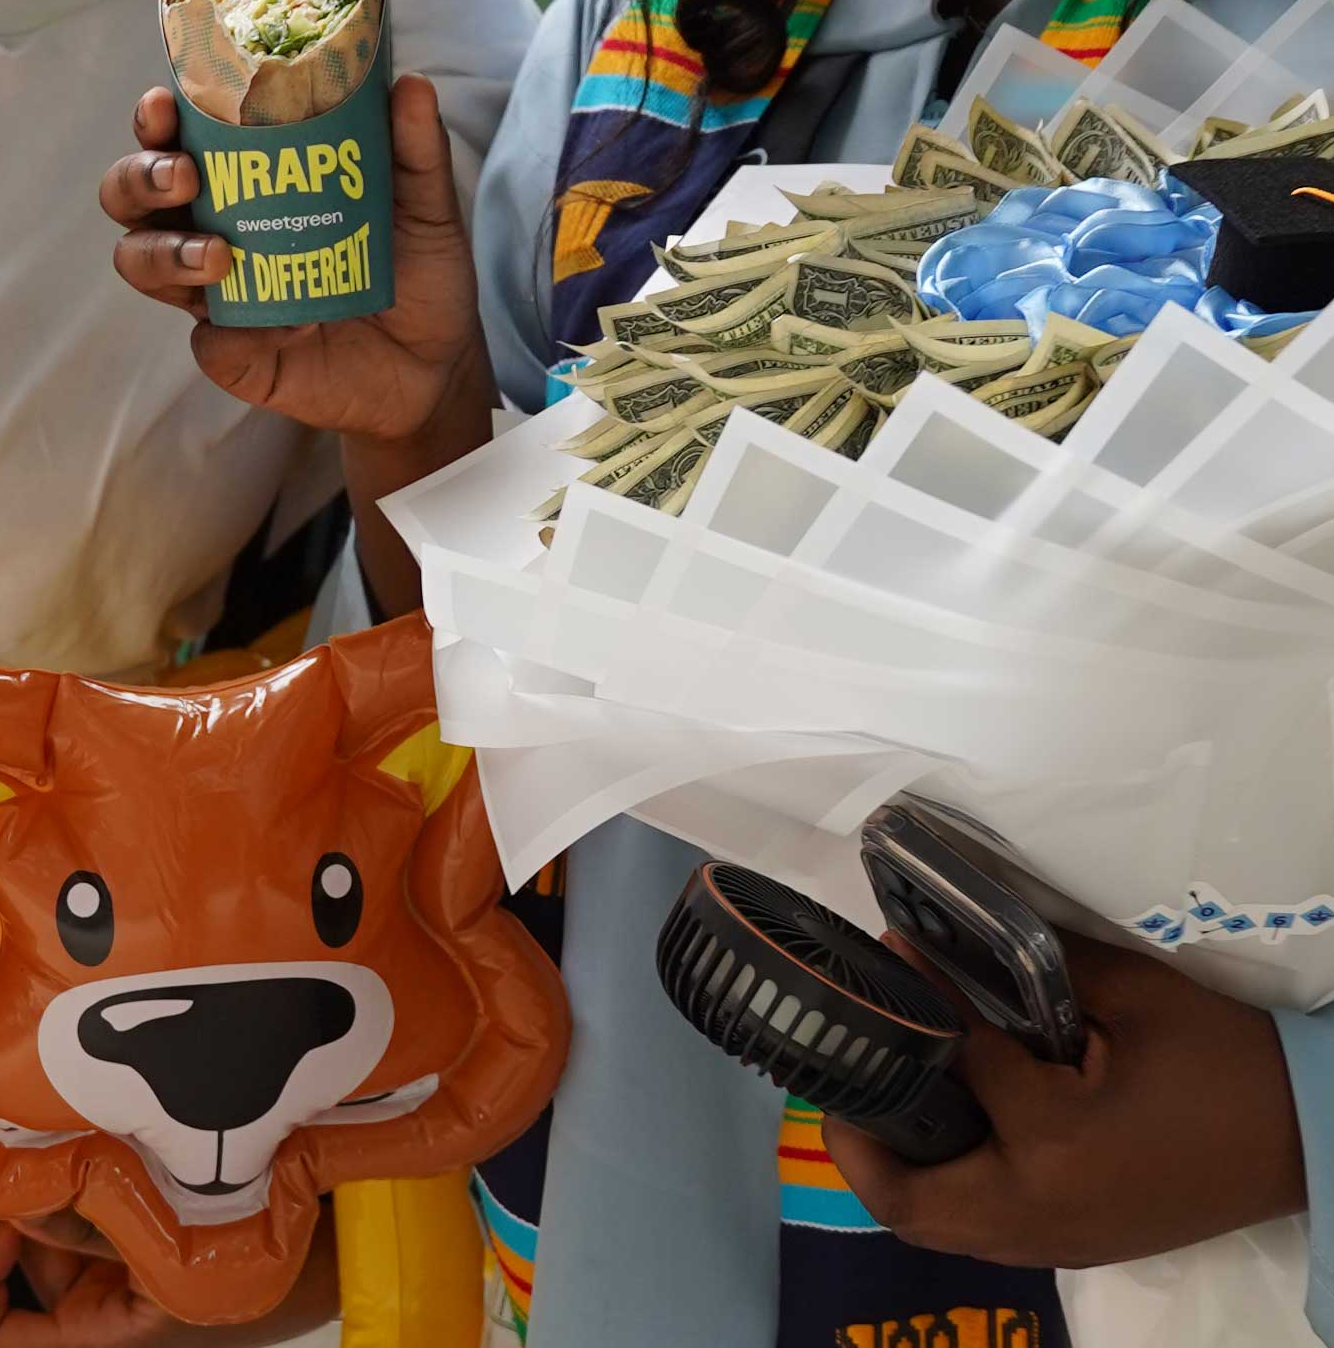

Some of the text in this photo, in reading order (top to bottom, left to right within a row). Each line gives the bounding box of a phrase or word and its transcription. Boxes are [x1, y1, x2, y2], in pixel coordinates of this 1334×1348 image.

[203, 138, 365, 214] WRAPS
[236, 210, 344, 233] sweetgreen
[251, 221, 372, 302] DIFFERENT
